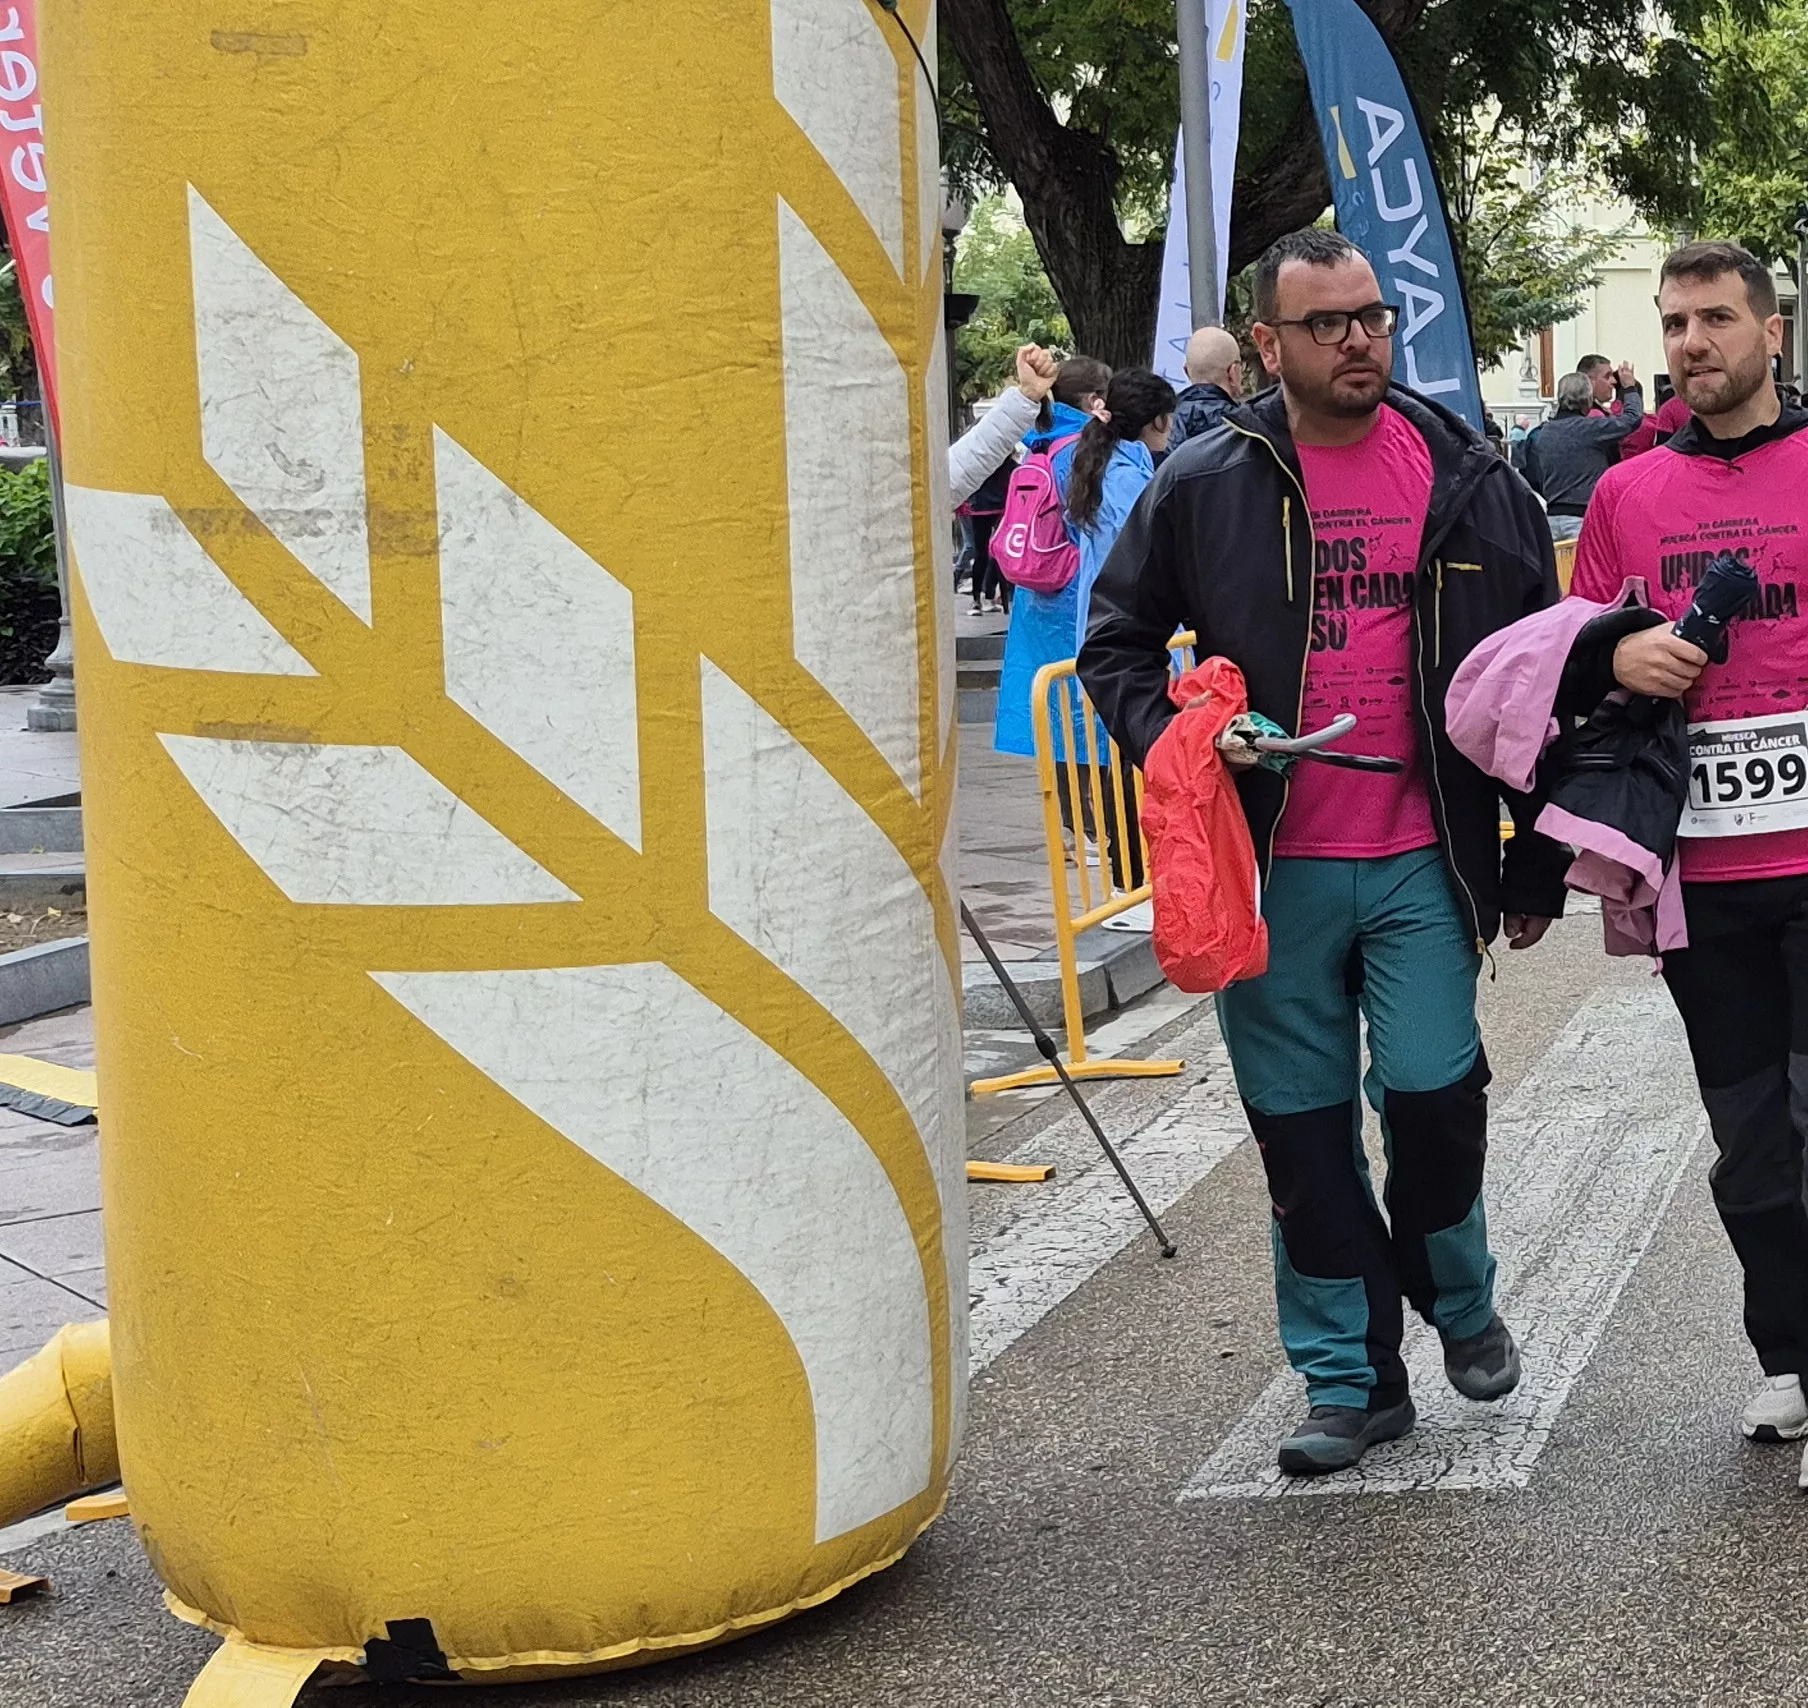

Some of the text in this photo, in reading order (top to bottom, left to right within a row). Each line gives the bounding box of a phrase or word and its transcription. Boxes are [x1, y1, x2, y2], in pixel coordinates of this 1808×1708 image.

[1313, 574, 1345, 611] EN
[1690, 735, 1801, 757] CONTRA EL CÁNCER
[1692, 754, 1807, 803] 1599
